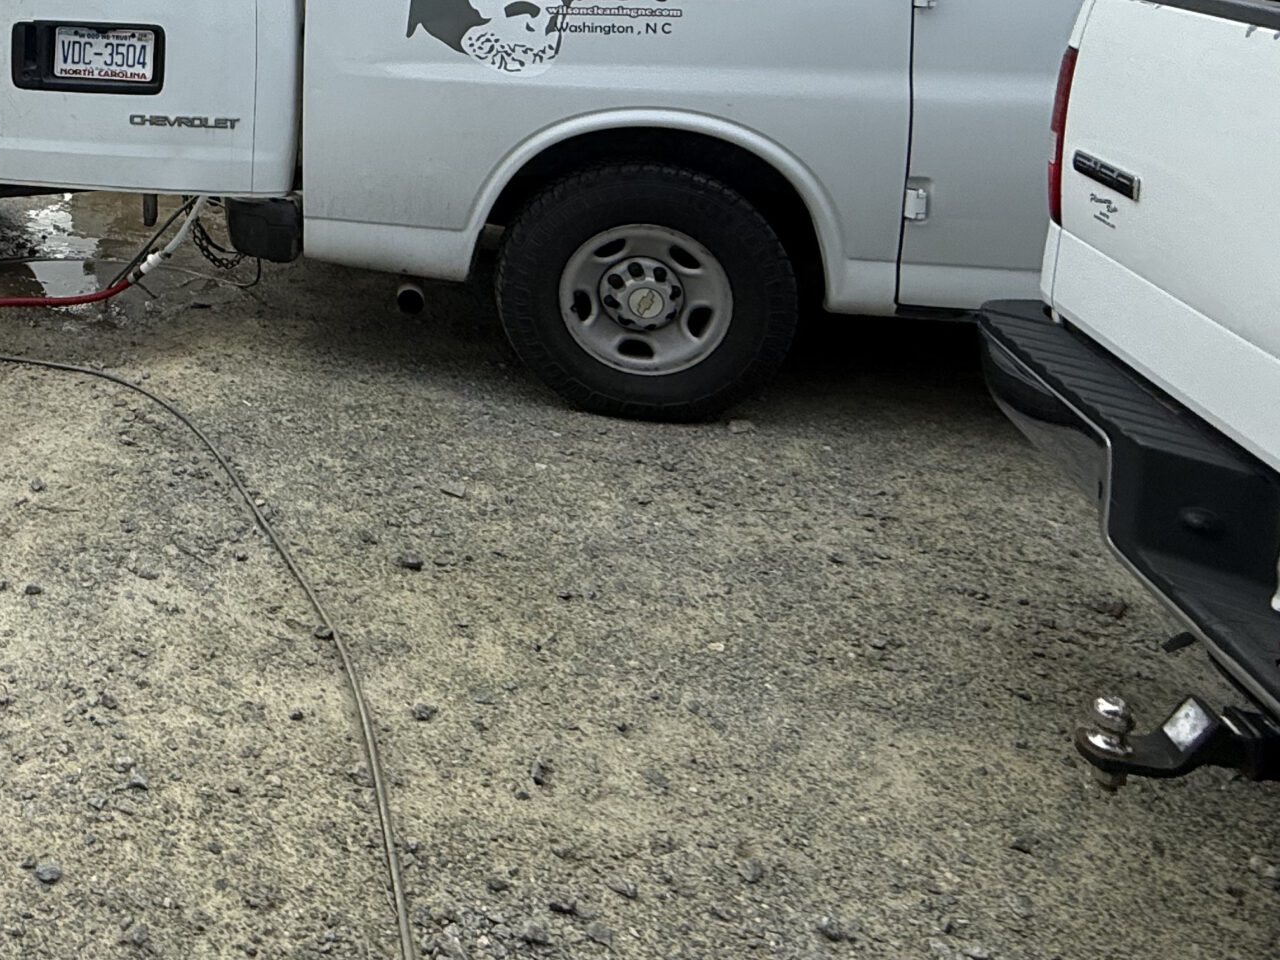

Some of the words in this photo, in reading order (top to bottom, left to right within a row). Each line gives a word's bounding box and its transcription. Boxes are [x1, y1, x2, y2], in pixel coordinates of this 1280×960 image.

[545, 4, 684, 19] wilsoncleaningnc.com
[61, 39, 148, 69] VDC-3504
[60, 68, 94, 77] NORTH
[98, 69, 148, 80] CAROLINA
[129, 114, 241, 130] CHEVROLET
